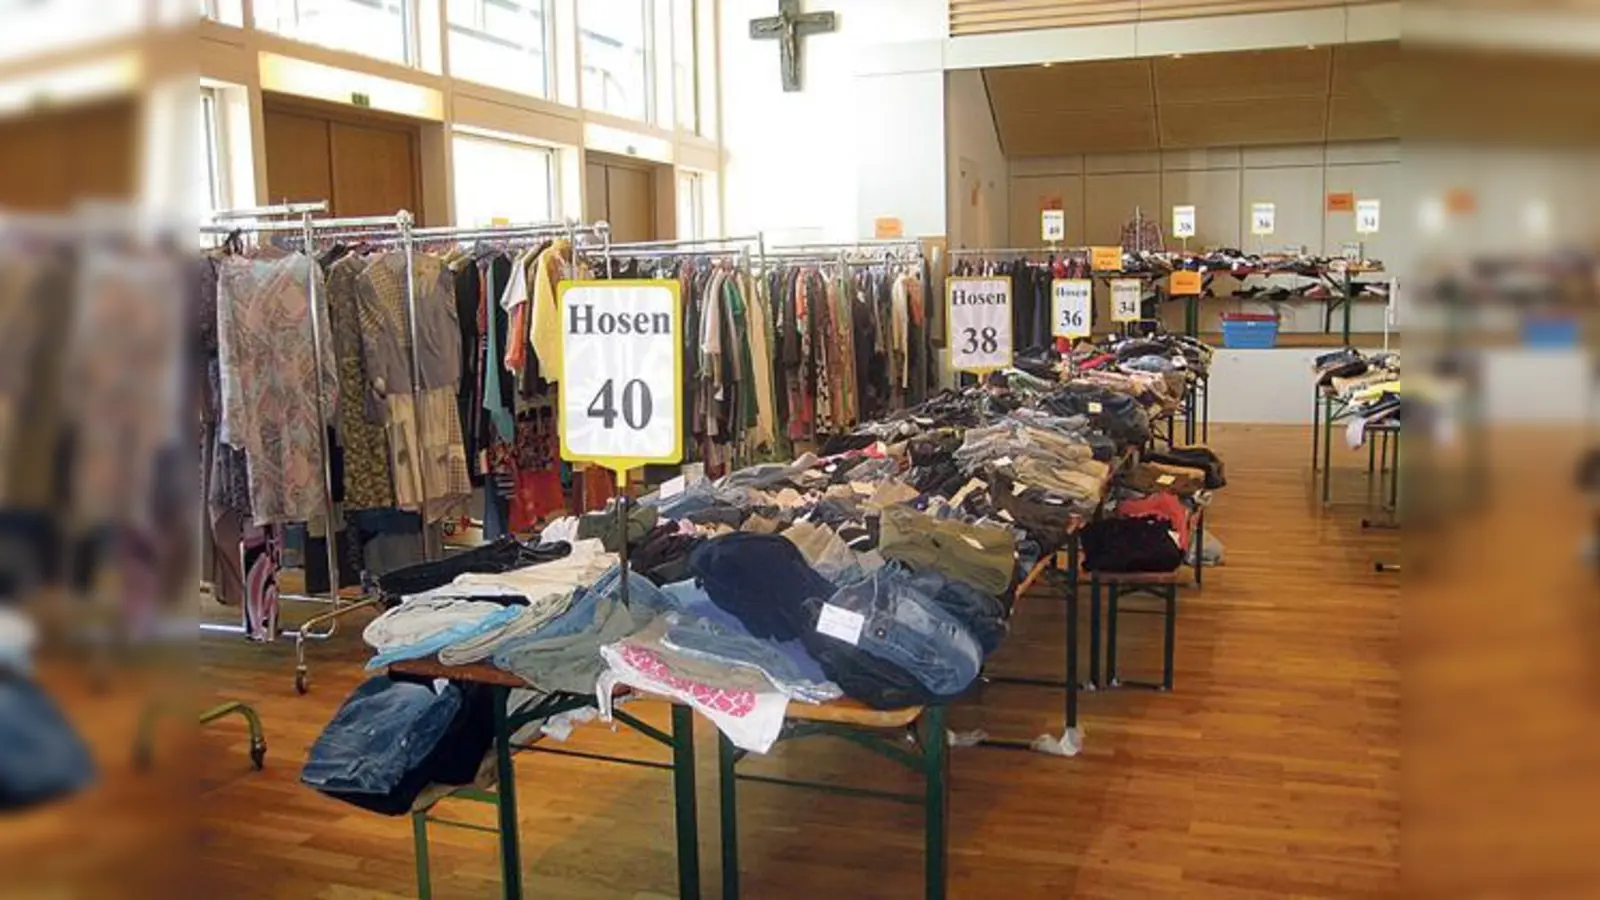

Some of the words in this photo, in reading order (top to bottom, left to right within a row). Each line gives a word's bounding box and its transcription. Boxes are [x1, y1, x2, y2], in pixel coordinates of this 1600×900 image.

[951, 289, 1007, 306] Hosen
[1055, 286, 1089, 297] Hosen
[1118, 301, 1136, 314] 34
[568, 304, 671, 335] Hosen
[1060, 310, 1083, 327] 36
[961, 326, 999, 355] 38
[587, 378, 653, 431] 40
